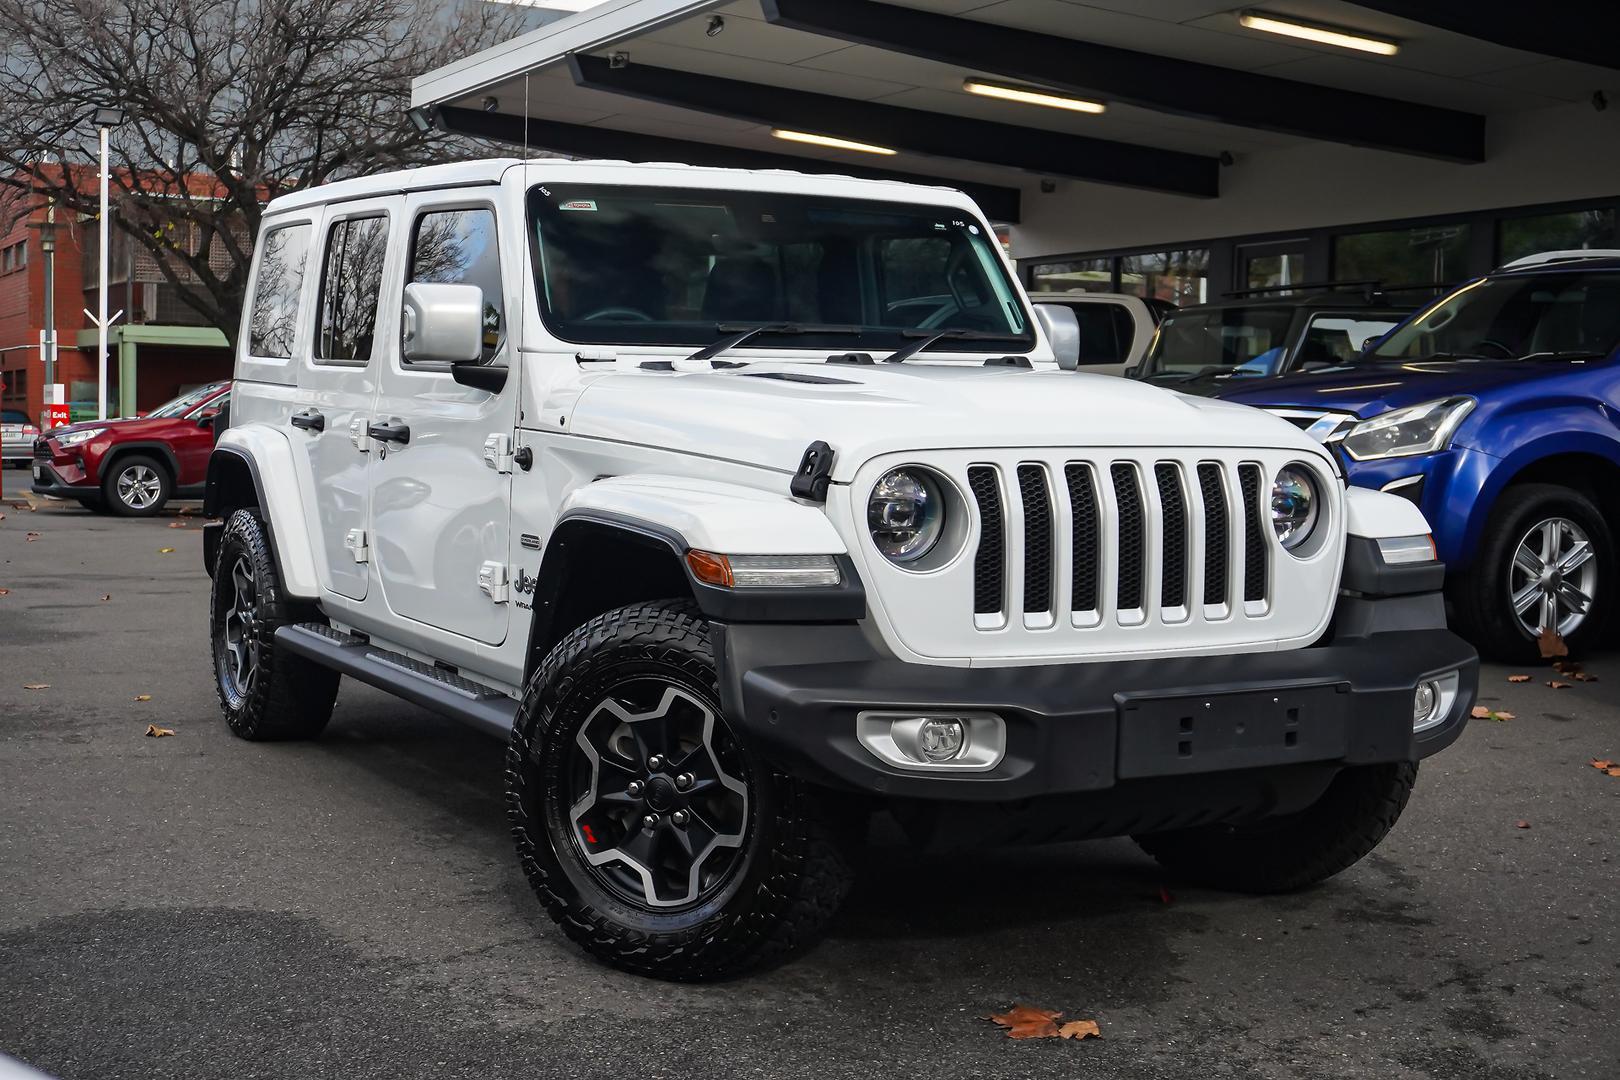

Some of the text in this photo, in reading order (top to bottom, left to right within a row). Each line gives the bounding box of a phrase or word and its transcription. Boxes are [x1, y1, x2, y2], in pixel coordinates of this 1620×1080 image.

[52, 411, 67, 419] Exit
[514, 568, 537, 594] Jee
[515, 600, 532, 611] WRA
